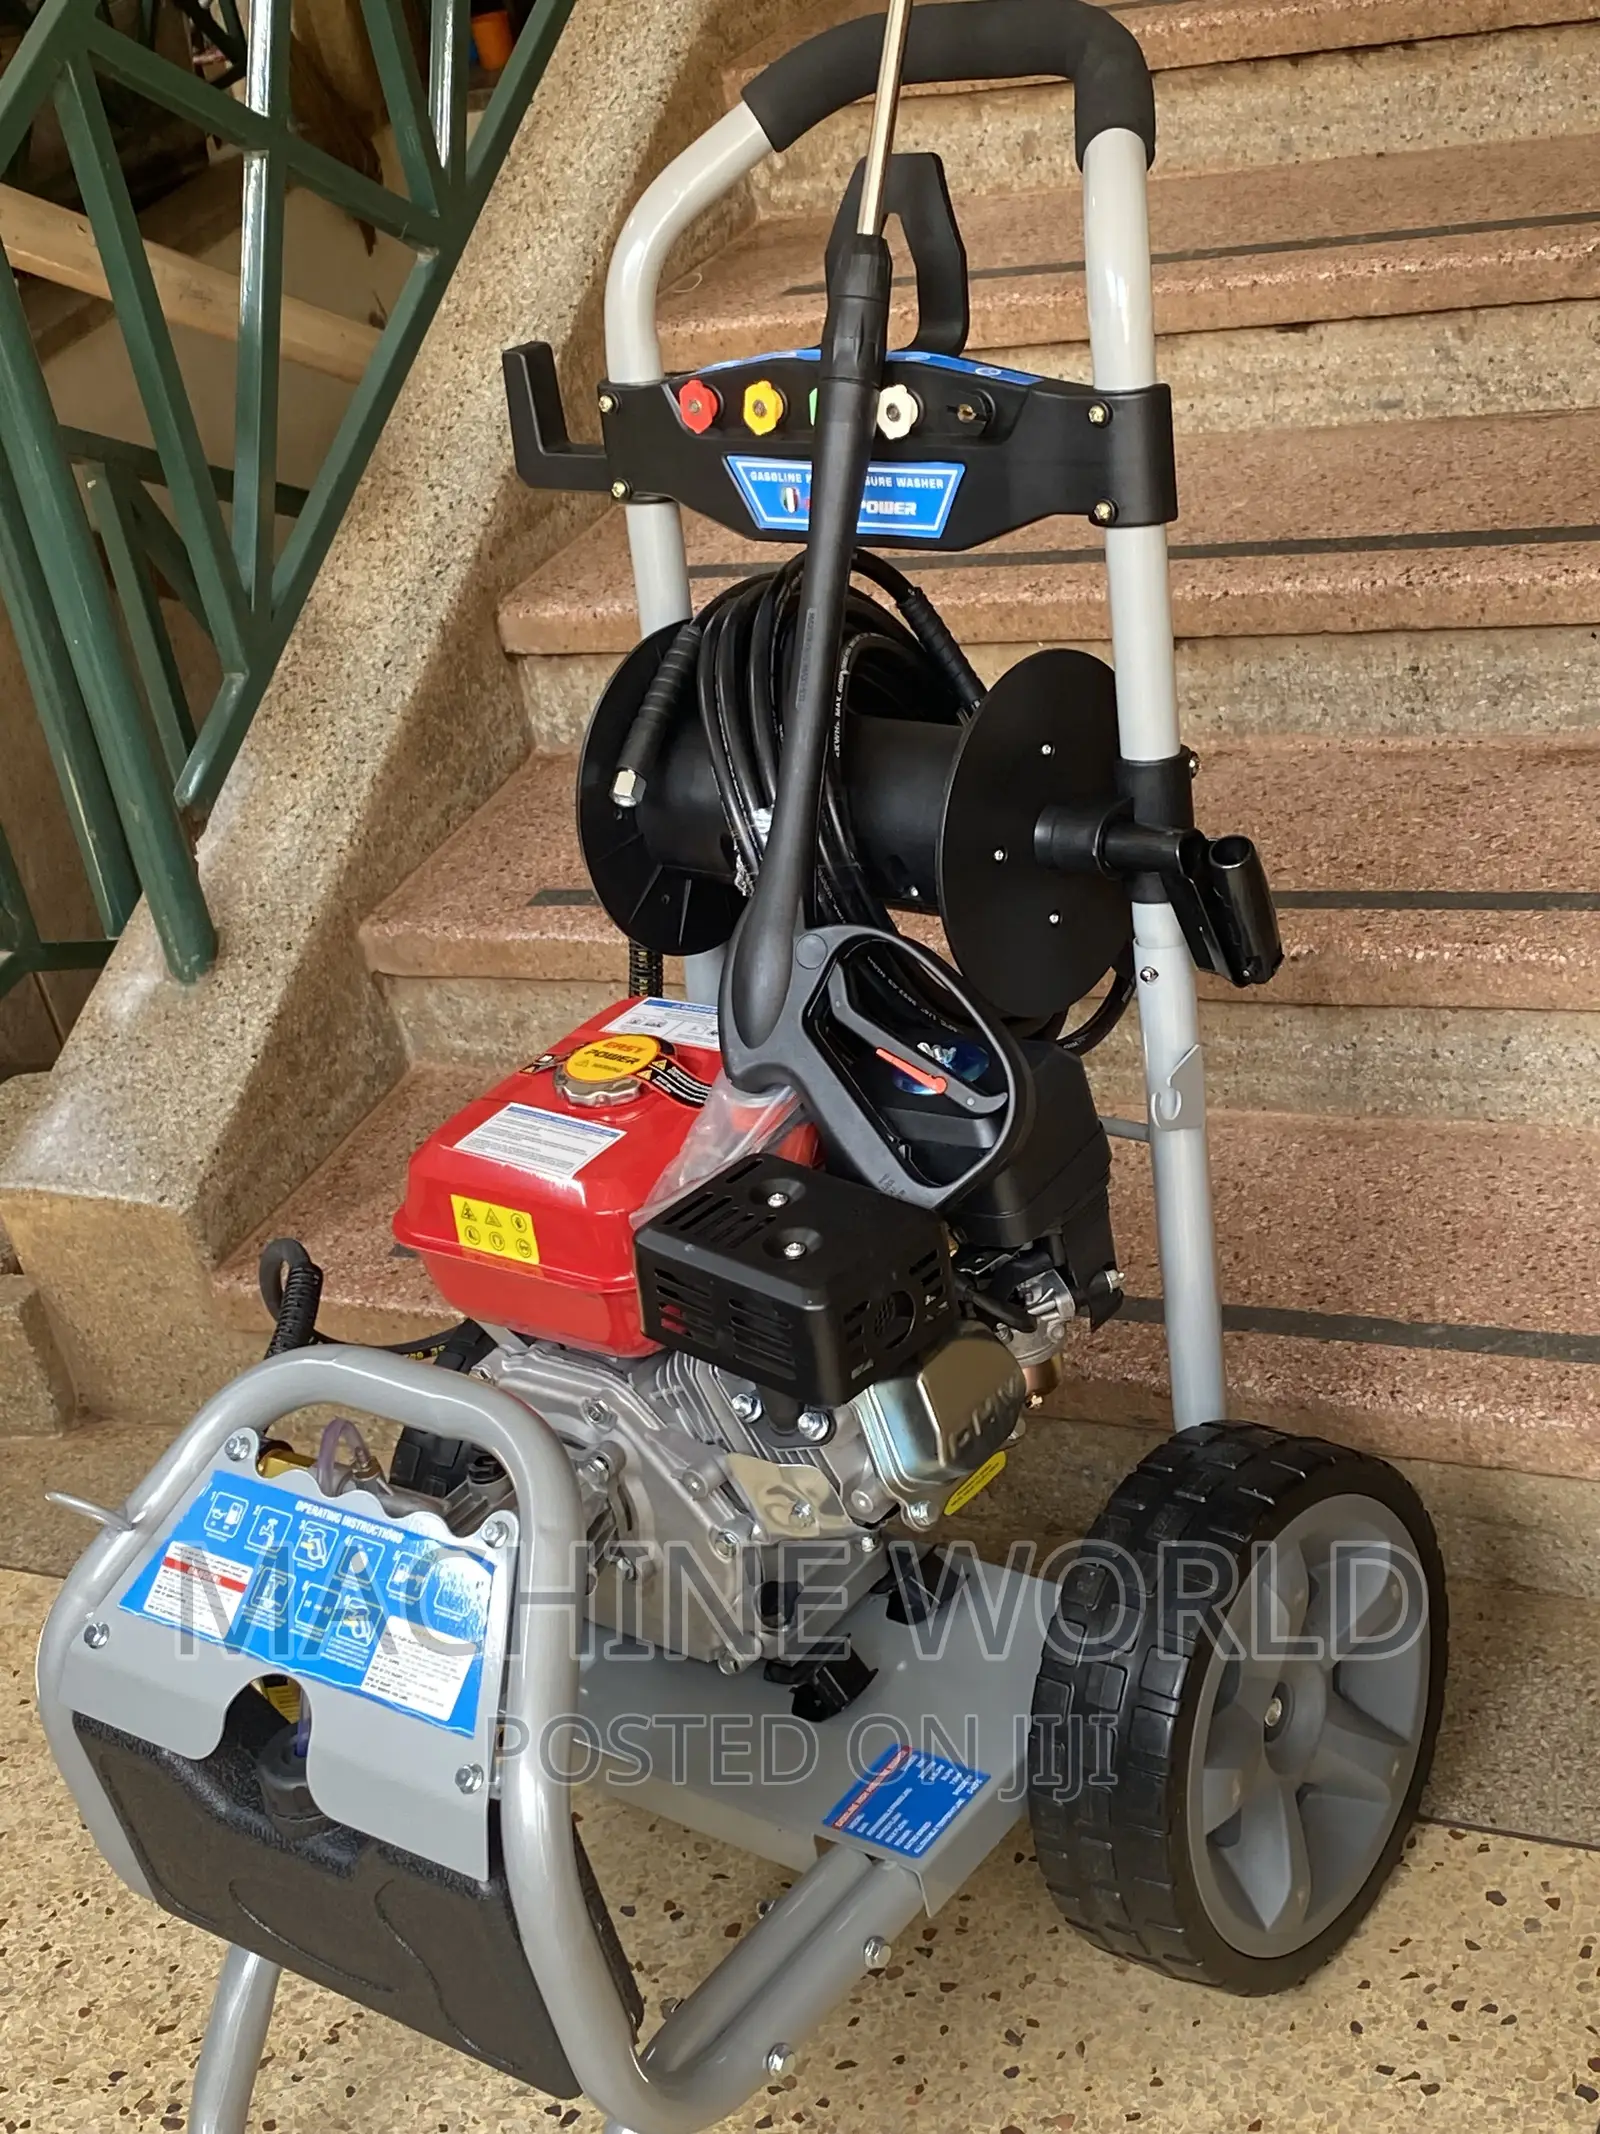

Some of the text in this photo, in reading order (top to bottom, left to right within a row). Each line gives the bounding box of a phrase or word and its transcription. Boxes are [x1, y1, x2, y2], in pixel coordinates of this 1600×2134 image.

[750, 471, 802, 483] GASOLINE
[864, 476, 892, 488] SURE
[896, 477, 944, 489] WASHER
[584, 1048, 641, 1065] POWER
[295, 1501, 405, 1544] OPERATING INSTRUCTIONS
